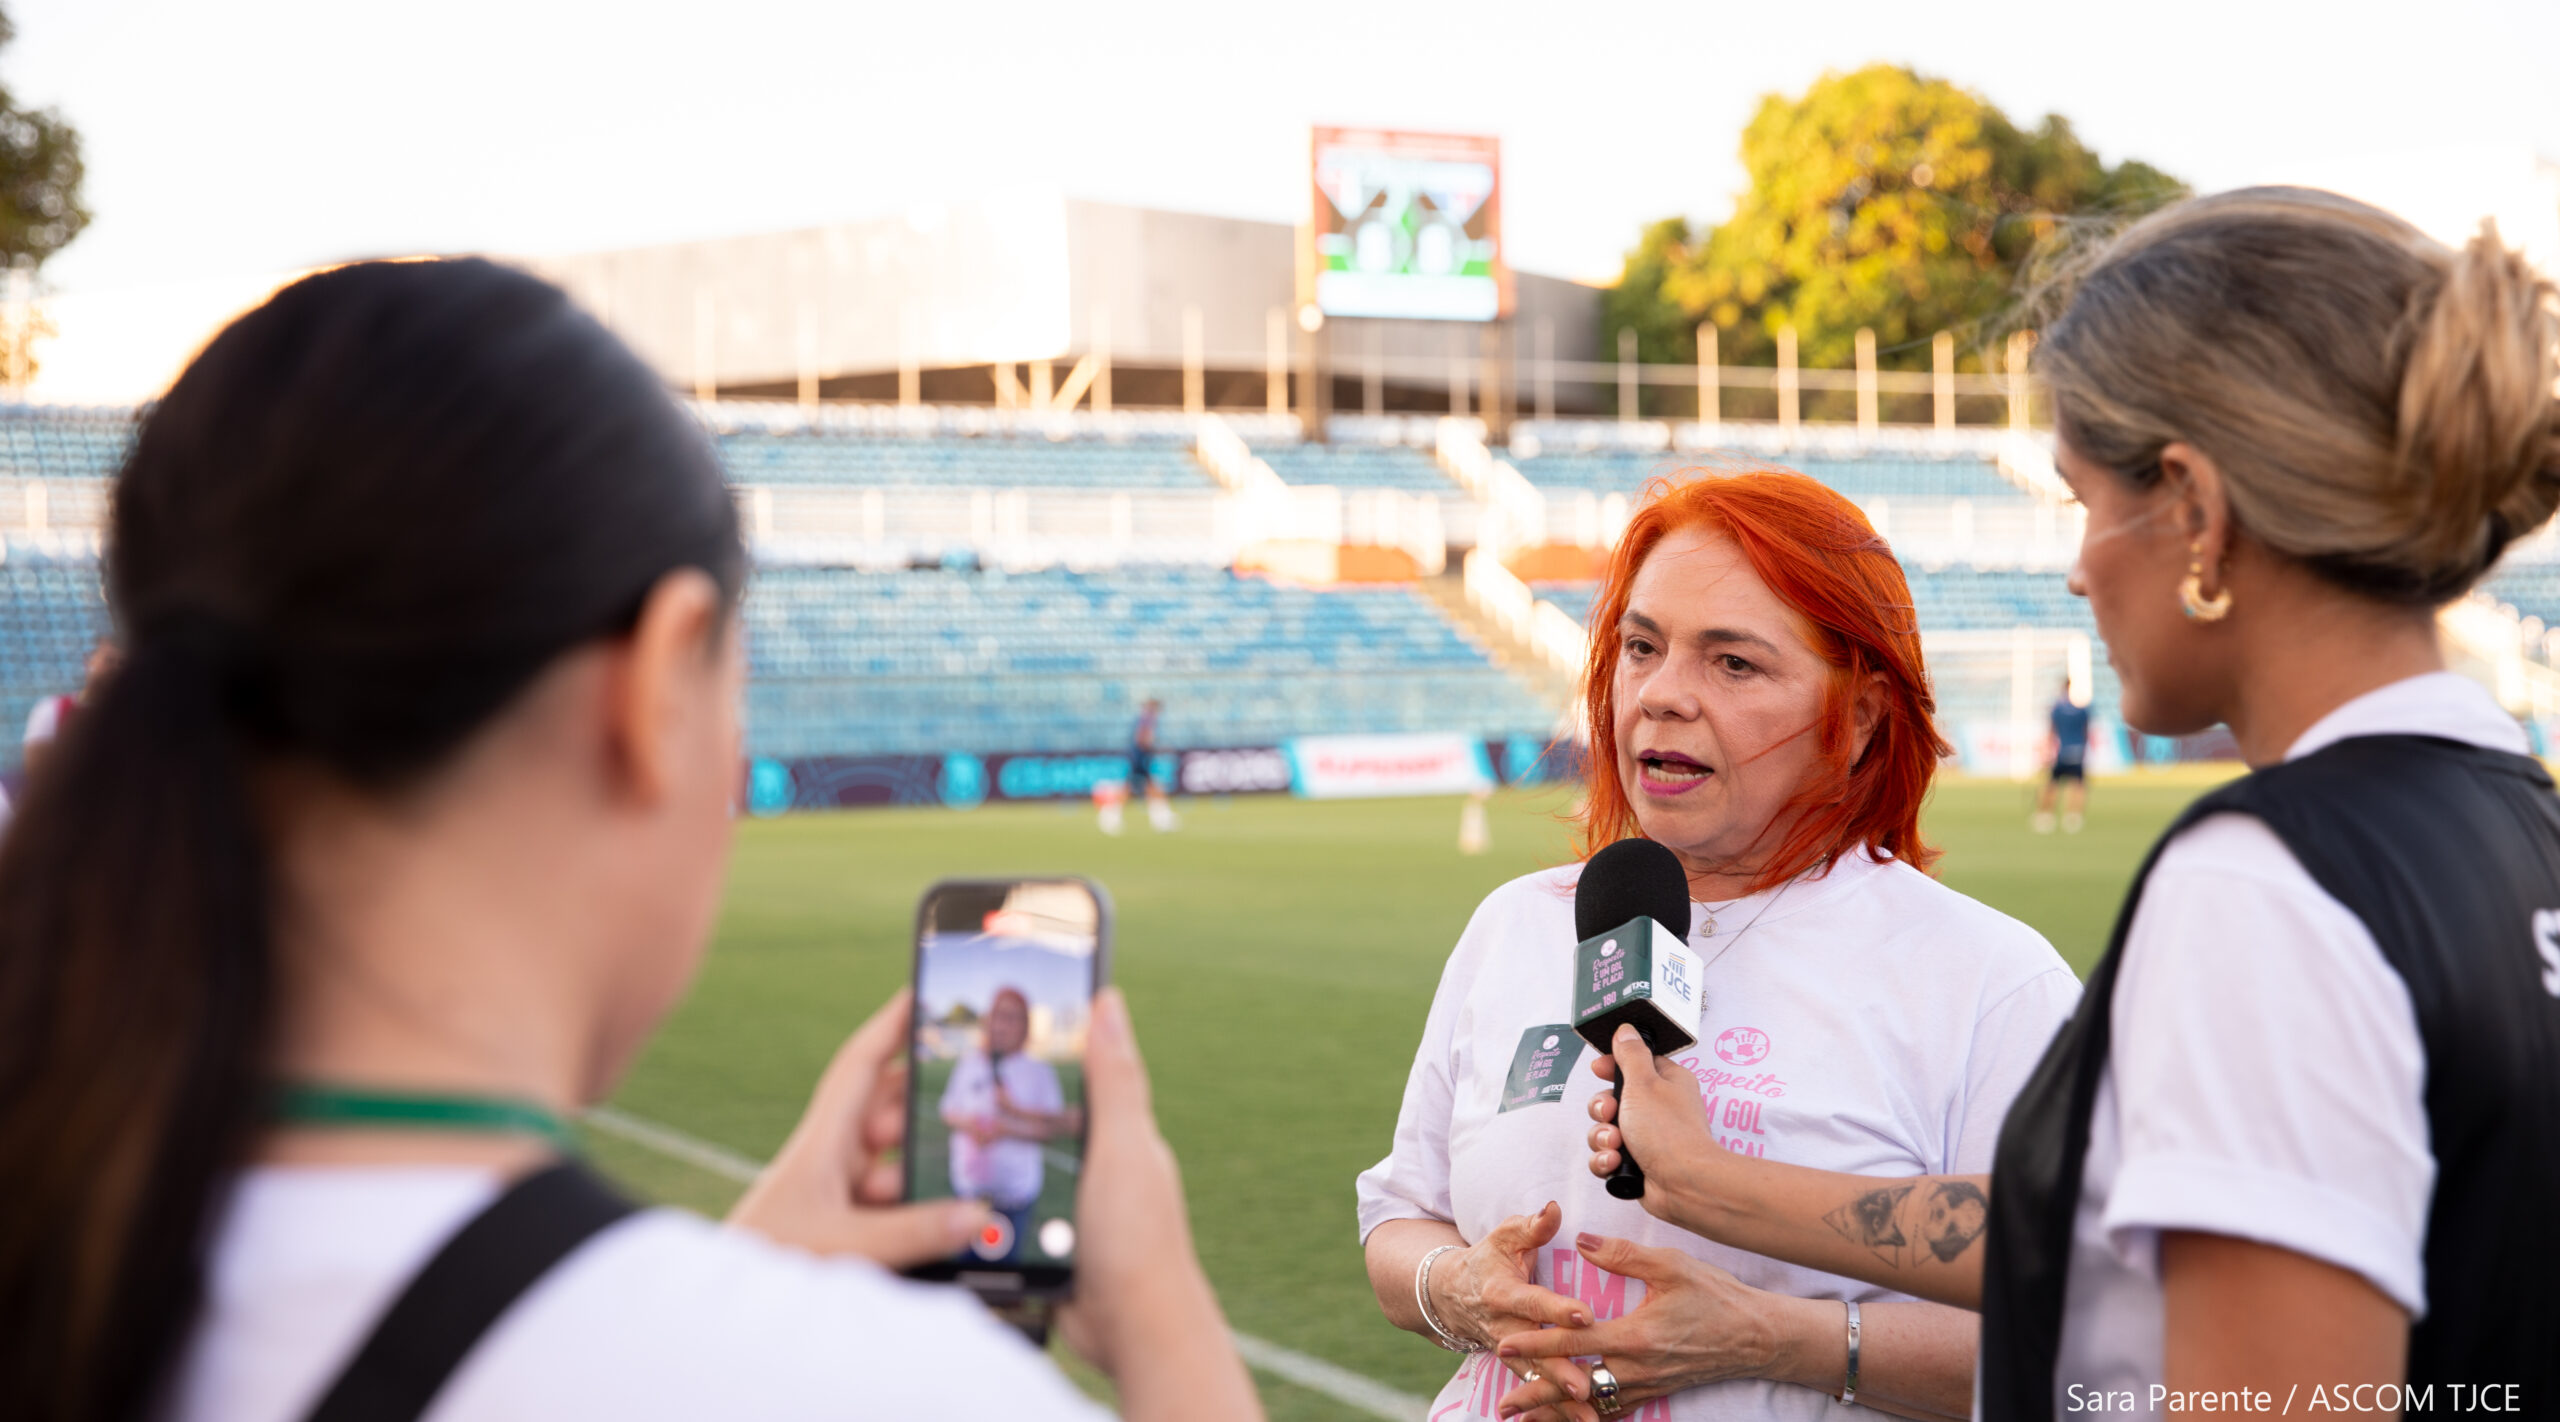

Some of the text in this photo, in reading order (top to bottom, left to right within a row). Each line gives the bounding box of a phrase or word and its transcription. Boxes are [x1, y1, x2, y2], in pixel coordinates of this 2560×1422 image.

[1593, 982, 1601, 992] DE
[1631, 980, 1651, 990] TJCE
[1662, 964, 1691, 1001] TJCE
[1603, 991, 1616, 1007] 180
[1723, 1098, 1765, 1135] GOL
